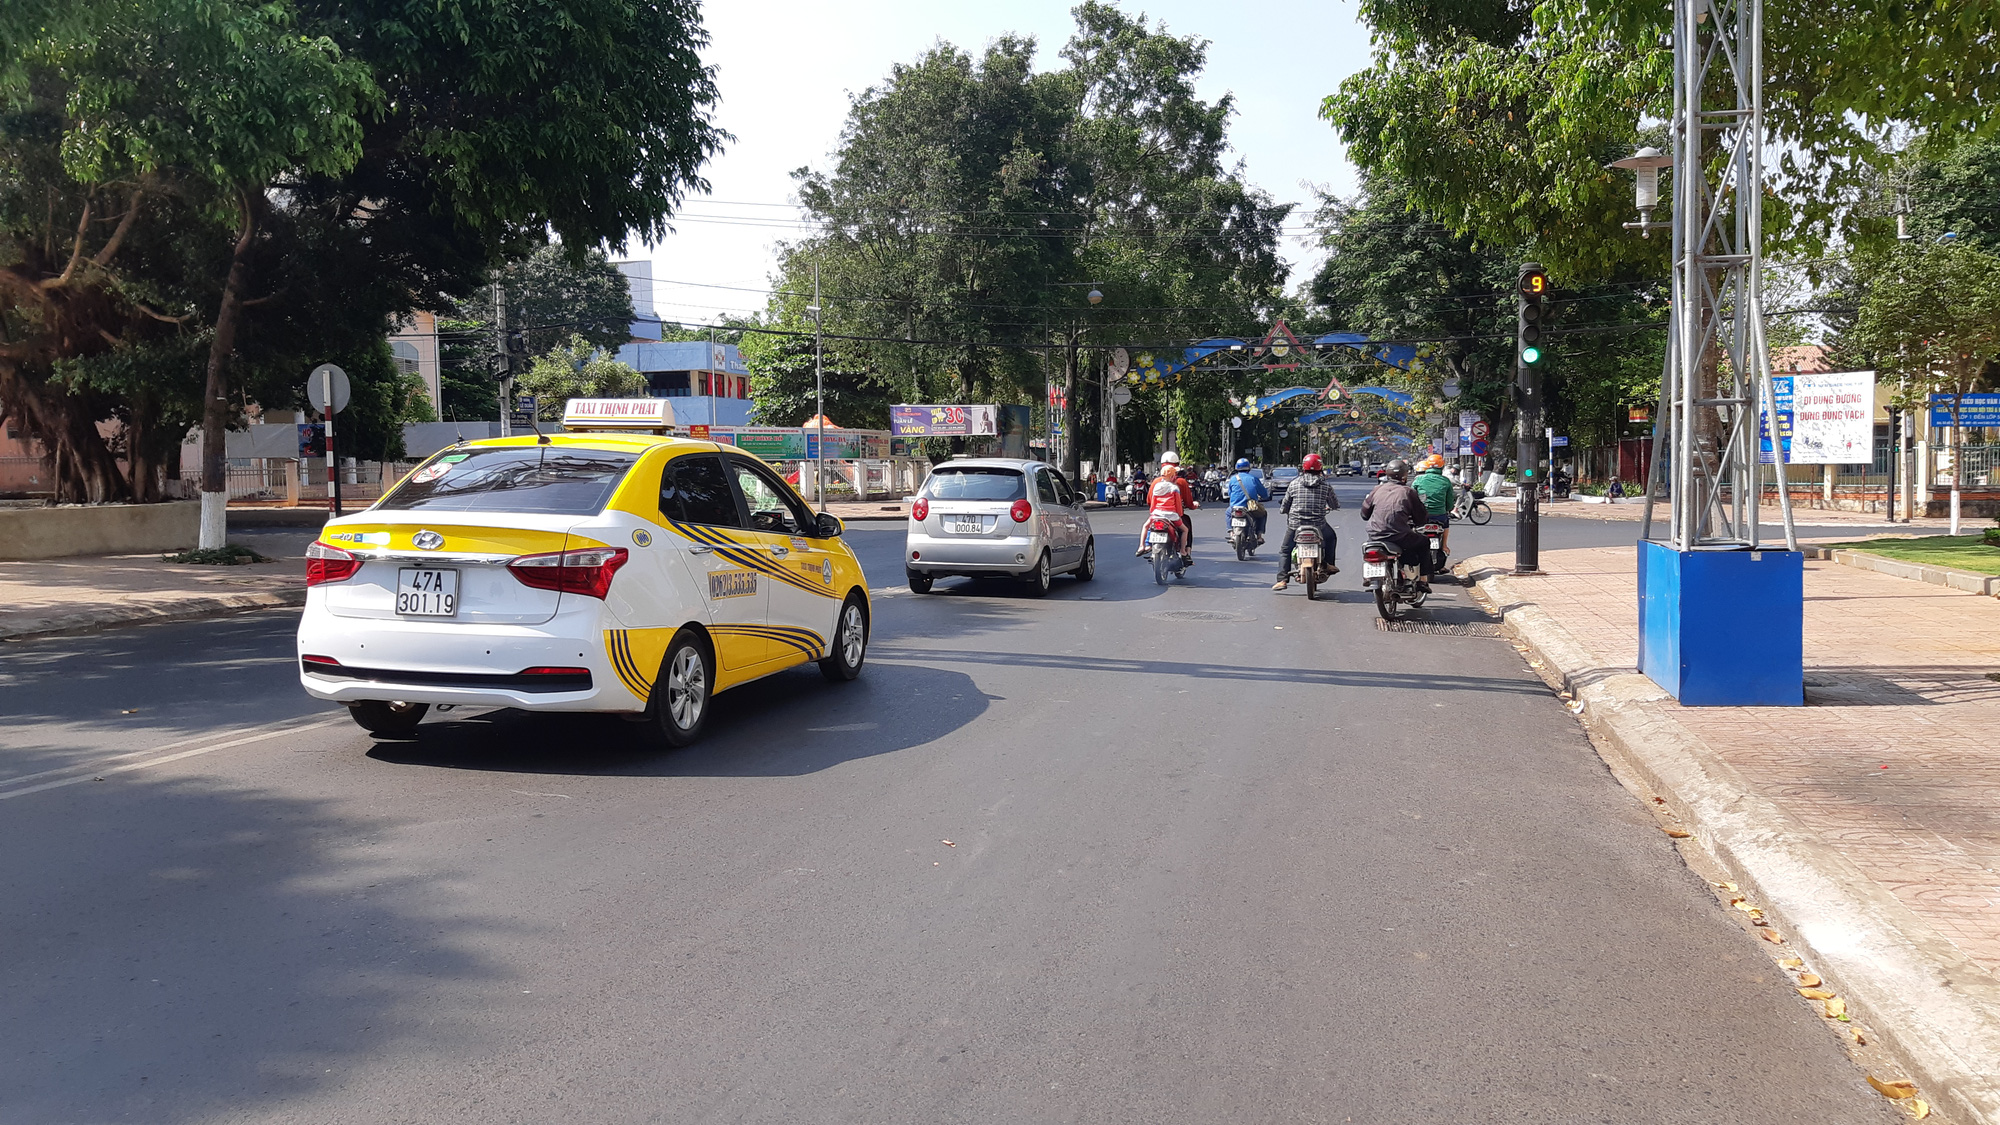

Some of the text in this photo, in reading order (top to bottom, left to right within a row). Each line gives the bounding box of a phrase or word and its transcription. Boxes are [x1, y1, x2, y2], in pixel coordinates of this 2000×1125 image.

[1532, 276, 1542, 292] 9
[1526, 387, 1532, 395] 3
[575, 401, 658, 417] TAXI THỊNH PHÁT
[900, 425, 925, 434] VÀNG
[961, 515, 976, 523] 47D
[956, 523, 981, 533] 000.84
[412, 571, 443, 592] 47A
[399, 593, 454, 613] 301.19
